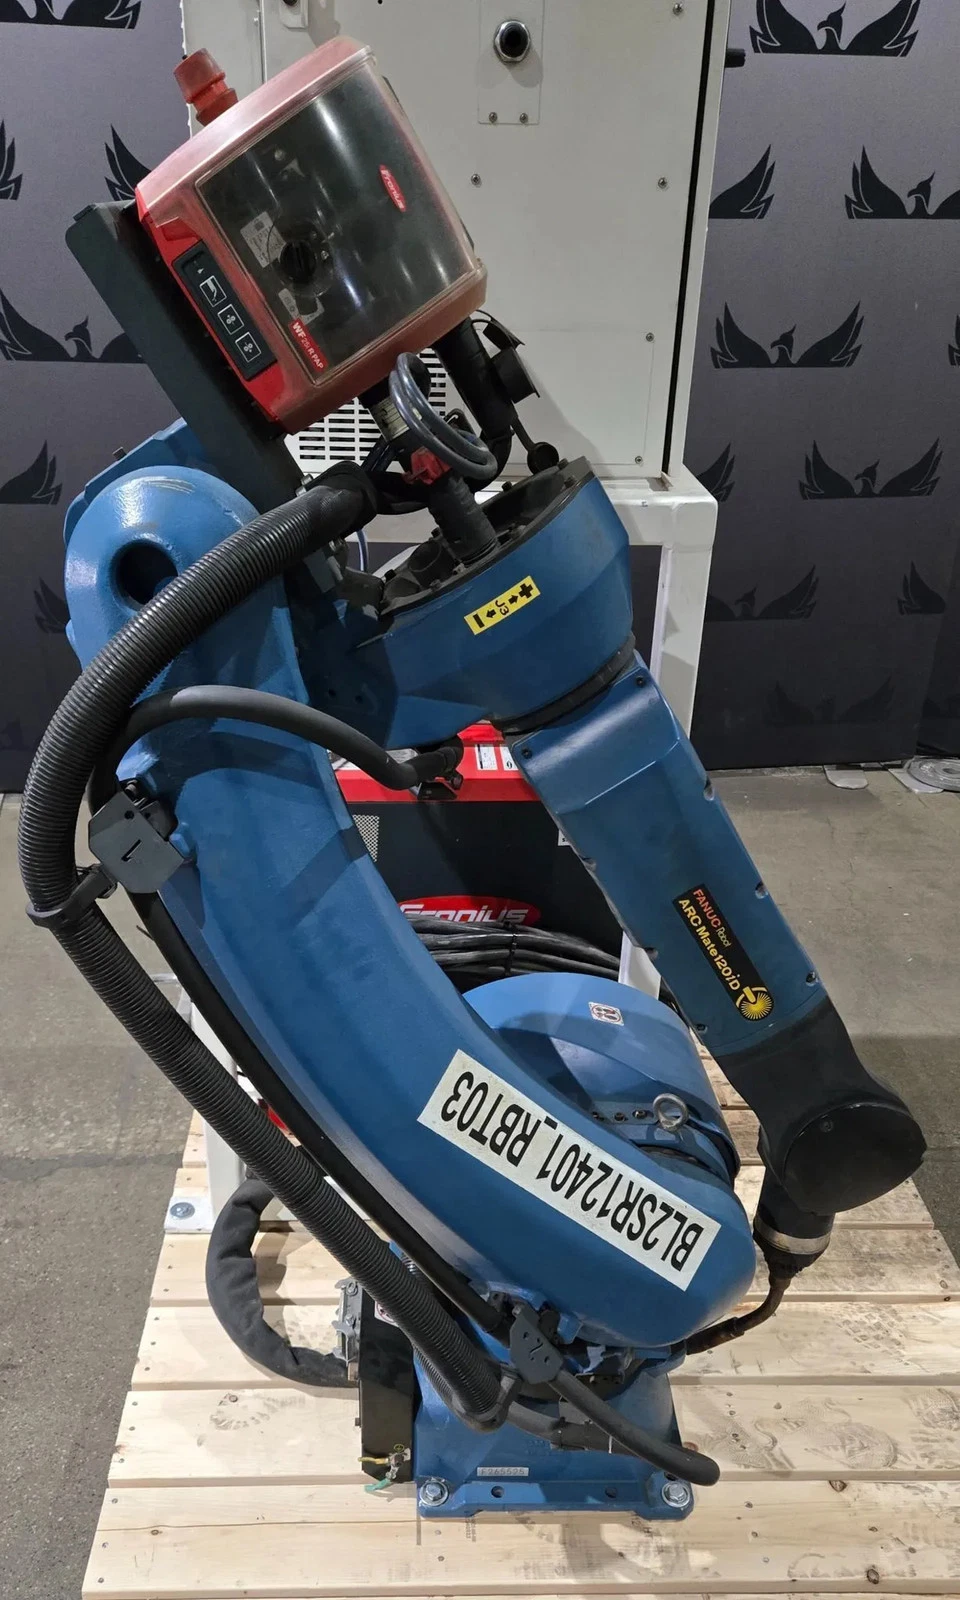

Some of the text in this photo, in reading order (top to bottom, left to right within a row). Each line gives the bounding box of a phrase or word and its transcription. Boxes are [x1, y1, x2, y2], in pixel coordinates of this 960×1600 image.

[293, 322, 307, 338] WF
[307, 347, 315, 355] R
[311, 354, 324, 369] PAP
[495, 600, 510, 616] J3
[679, 899, 702, 927] ARC
[693, 889, 731, 947] FANUC Robot
[440, 1071, 704, 1272] BL2SR12401_RBT03
